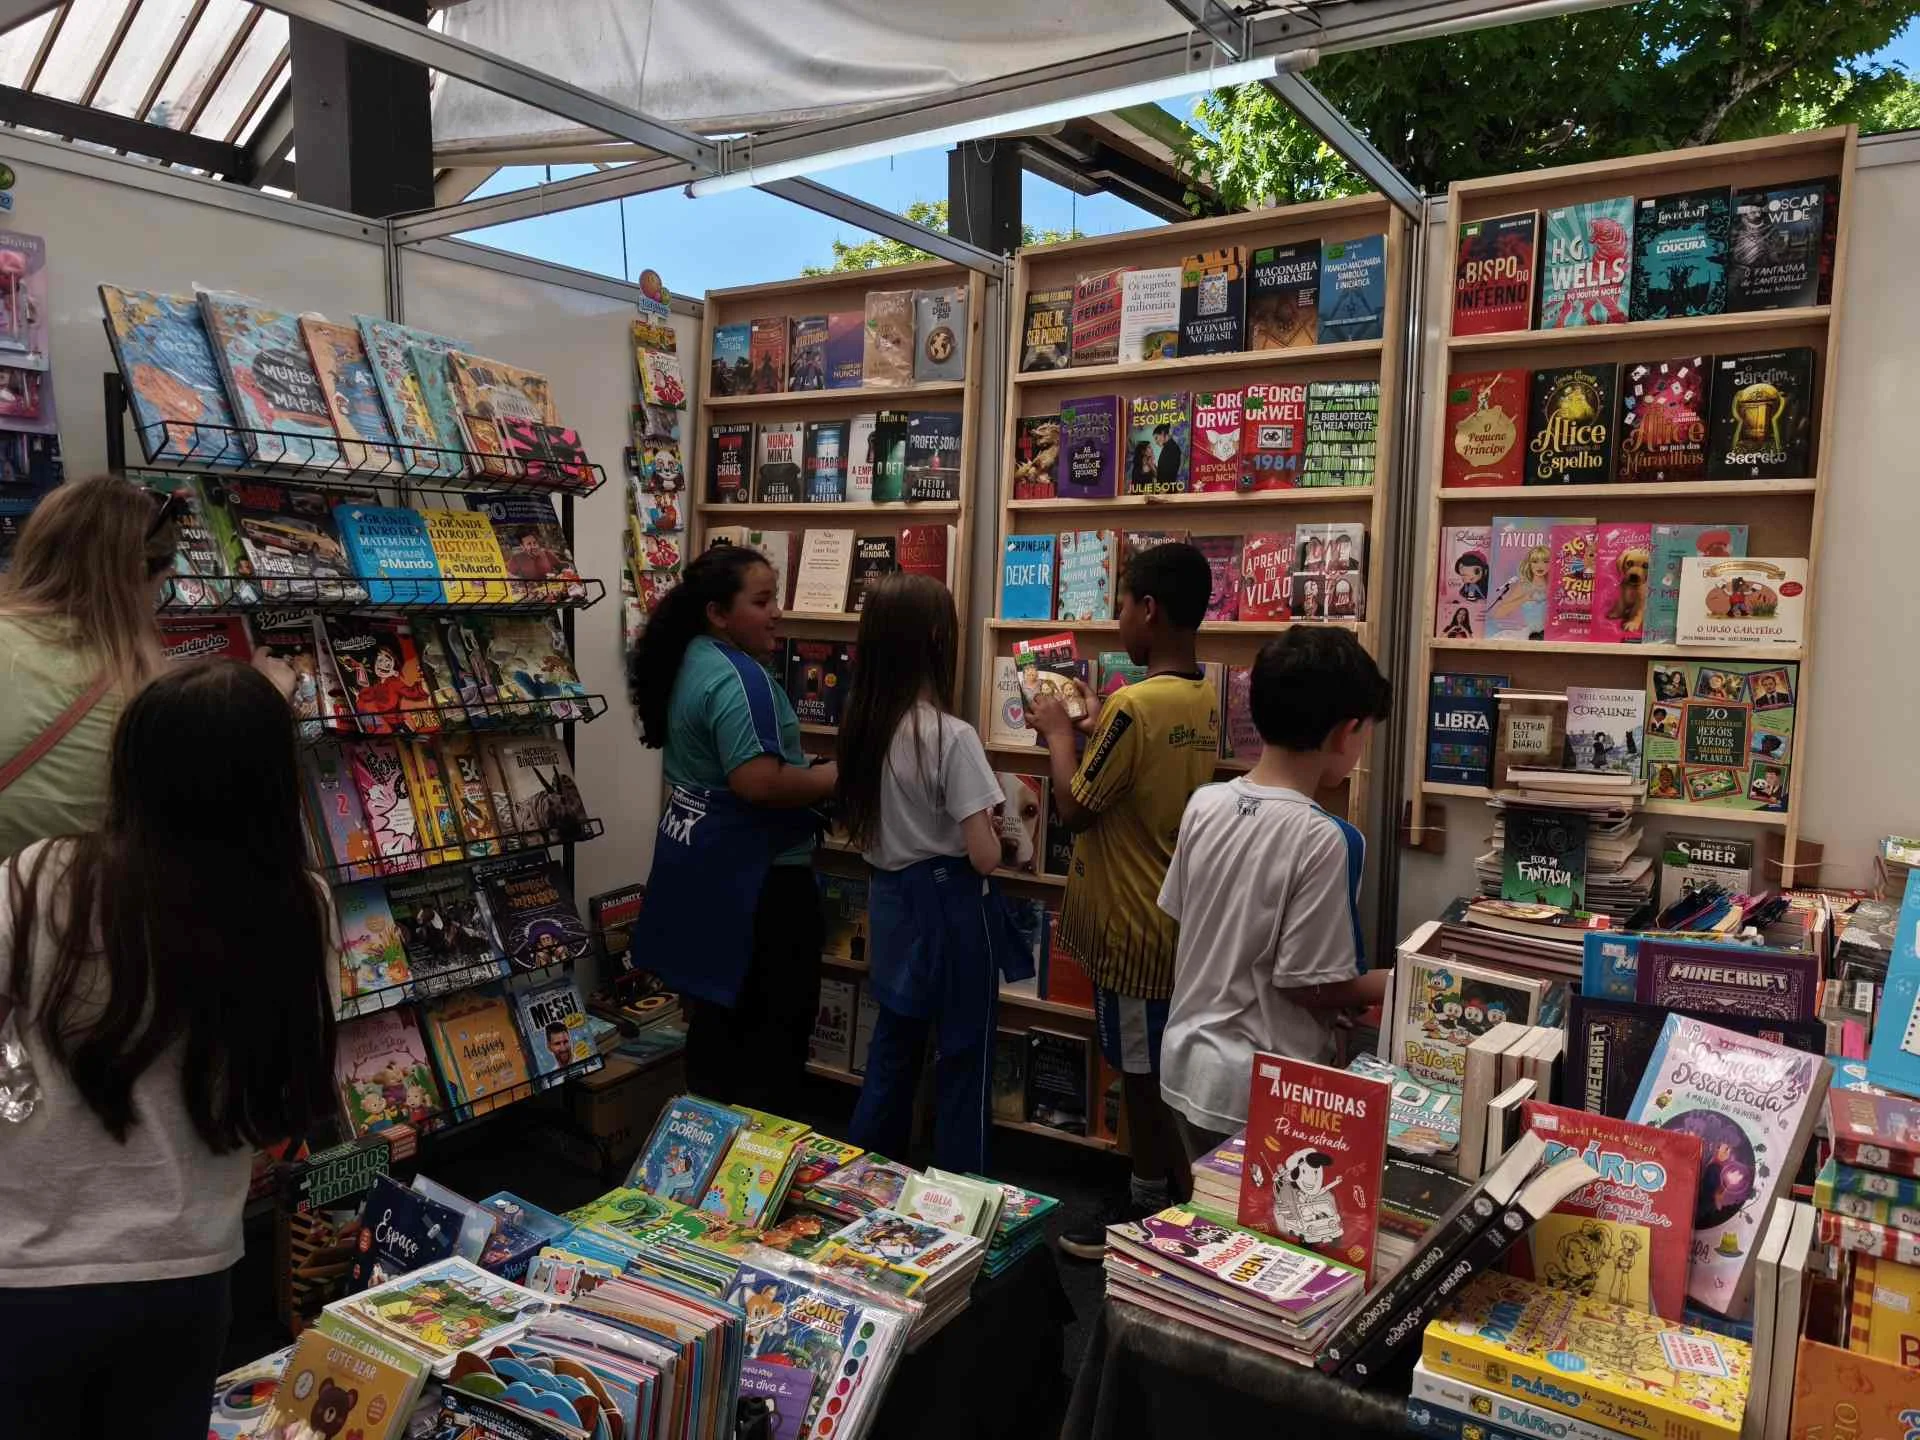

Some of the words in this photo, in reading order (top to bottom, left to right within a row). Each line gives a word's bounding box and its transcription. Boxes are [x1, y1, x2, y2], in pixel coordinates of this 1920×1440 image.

[1769, 193, 1819, 211] OSCAR
[1768, 208, 1810, 225] WILDE
[1656, 240, 1707, 254] LOUCURA
[1255, 260, 1318, 278] MAÇONARIA
[1466, 256, 1517, 284] BISPO
[1551, 257, 1626, 291] WELLS
[1754, 264, 1806, 277] FANTASMA
[1078, 277, 1111, 299] QUEM
[1141, 280, 1177, 292] segredos
[1259, 275, 1275, 287] NO
[1277, 272, 1313, 285] BRASIL
[1456, 283, 1528, 310] INFERNO
[1076, 299, 1114, 322] PENSA
[1126, 300, 1176, 313] milionária
[1185, 321, 1239, 337] MAÇONARIA
[1190, 333, 1203, 344] NO
[1203, 331, 1232, 343] BRASIL
[1734, 367, 1788, 386] Jardim
[1133, 398, 1159, 413] NÃO
[1161, 399, 1177, 410] ME
[1133, 413, 1186, 427] ESQUEÇA
[1321, 412, 1373, 421] BIBLIOTECA
[1324, 421, 1373, 430] MEIA-NOITE
[1530, 408, 1606, 453] Alice
[767, 432, 794, 449] NUNCA
[910, 434, 960, 450] PROFESSORA
[1467, 432, 1507, 444] Pequeno
[767, 447, 793, 463] MINTA
[1253, 454, 1297, 471] 1984
[1620, 452, 1705, 475] Maravilhas
[1724, 450, 1788, 465] Secreto
[1537, 450, 1603, 479] Espelho
[1128, 482, 1153, 494] JULIE
[1156, 481, 1185, 492] SOTO
[438, 519, 485, 530] GRANDE
[359, 535, 427, 547] MATEMÁTICA
[430, 529, 463, 539] LIVRO
[1500, 532, 1543, 548] TAYLOR
[433, 539, 496, 553] HISTÓRIA
[859, 550, 890, 559] HENDRIX
[388, 559, 434, 569] Mundo
[1246, 546, 1295, 573] APRENDI
[462, 563, 502, 574] Mundo
[1005, 564, 1035, 586] DEIXE
[1037, 562, 1051, 586] IR
[1247, 576, 1293, 607] VILÃO
[1706, 625, 1731, 635] URSO
[1578, 692, 1597, 701] NEIL
[1599, 693, 1635, 703] GAIMAN
[1434, 711, 1490, 730] LIBRA
[1573, 705, 1637, 719] CORALINE
[1705, 708, 1729, 720] 20
[1697, 725, 1733, 738] HERÓIS
[1695, 736, 1734, 748] VERDES
[1701, 753, 1733, 764] PLANETA
[1677, 841, 1736, 864] SABER
[1517, 861, 1571, 888] FANTASIA
[1669, 961, 1788, 991] MINECRAFT
[530, 992, 579, 1031] MESSI
[1671, 1062, 1784, 1114] Desastrada
[1270, 1079, 1367, 1118] AVENTURAS
[1283, 1103, 1298, 1116] DE
[1300, 1105, 1343, 1133] MIKE
[669, 1120, 714, 1145] DORMIR
[1559, 1124, 1589, 1137] Rachel
[1622, 1134, 1657, 1155] Russell
[1308, 1132, 1350, 1152] estrada
[375, 1208, 420, 1258] Espaço
[1411, 1247, 1444, 1281] CADERNO
[1438, 1260, 1473, 1295] CADERNO
[326, 1349, 352, 1370] CUTE
[353, 1357, 377, 1379] BEAR
[756, 1380, 777, 1392] diva
[1510, 1373, 1583, 1408] DIÁRIO
[1497, 1405, 1568, 1439] DIÁRIO
